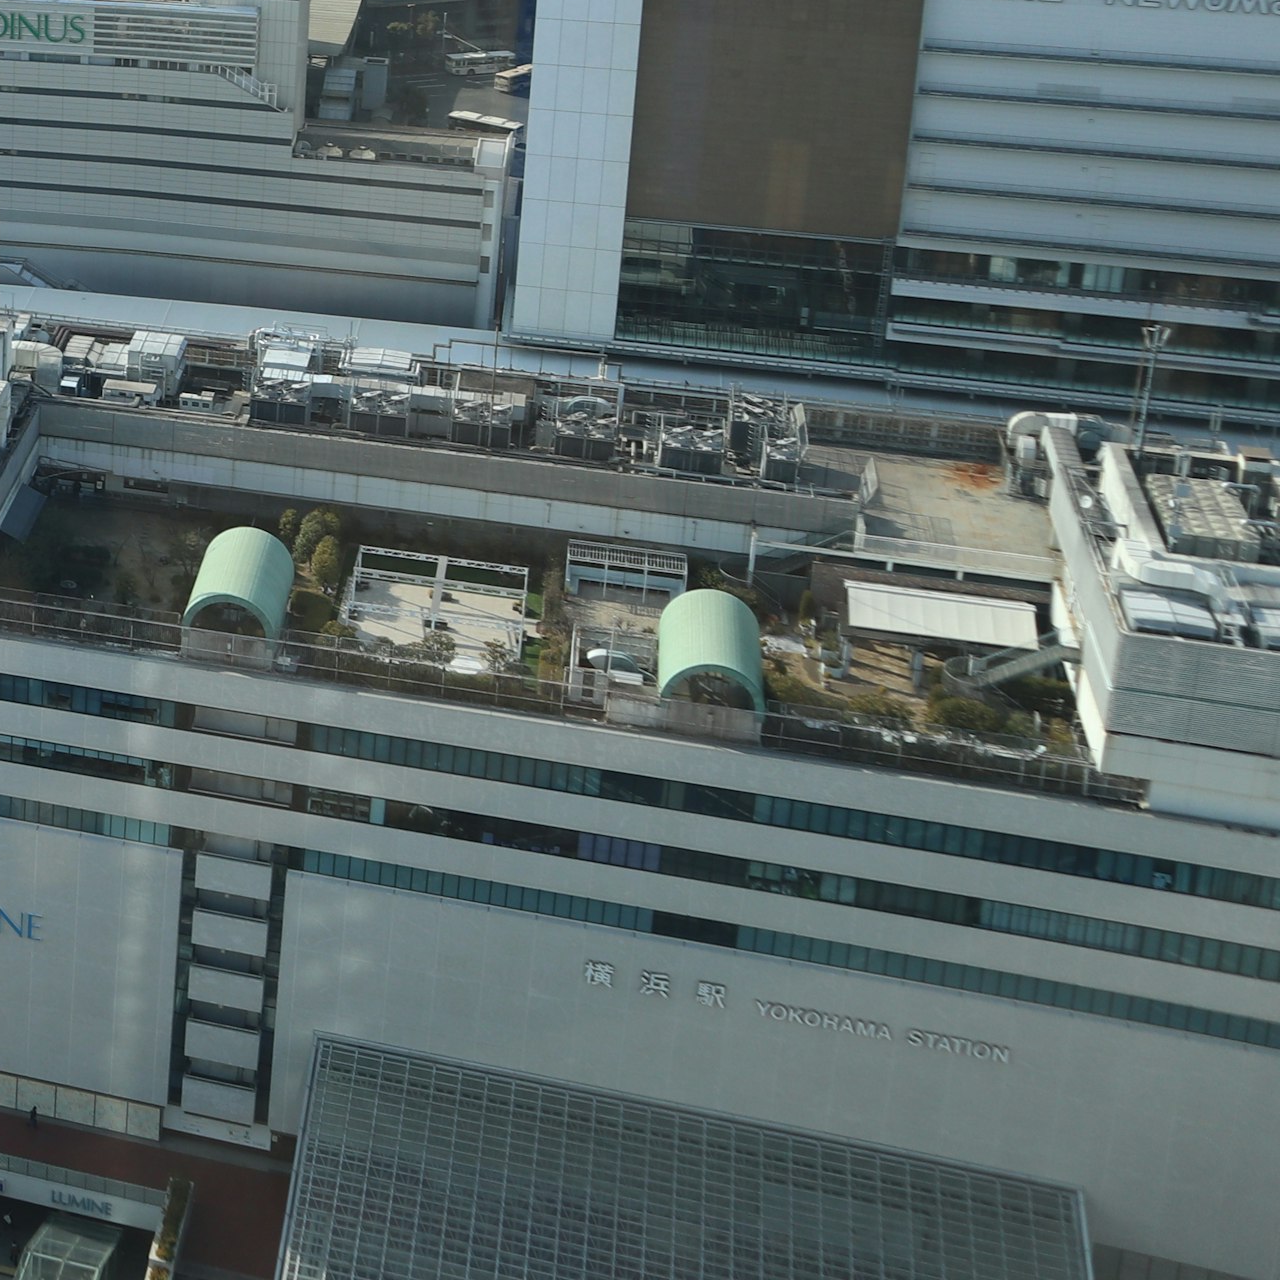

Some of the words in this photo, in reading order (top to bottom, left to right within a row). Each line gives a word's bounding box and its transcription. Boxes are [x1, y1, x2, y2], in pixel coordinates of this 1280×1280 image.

[584, 959, 727, 1009] 横浜駅
[755, 998, 892, 1042] YOKOHAMA
[907, 1028, 1010, 1064] STATION
[51, 1189, 113, 1217] LUMINE
